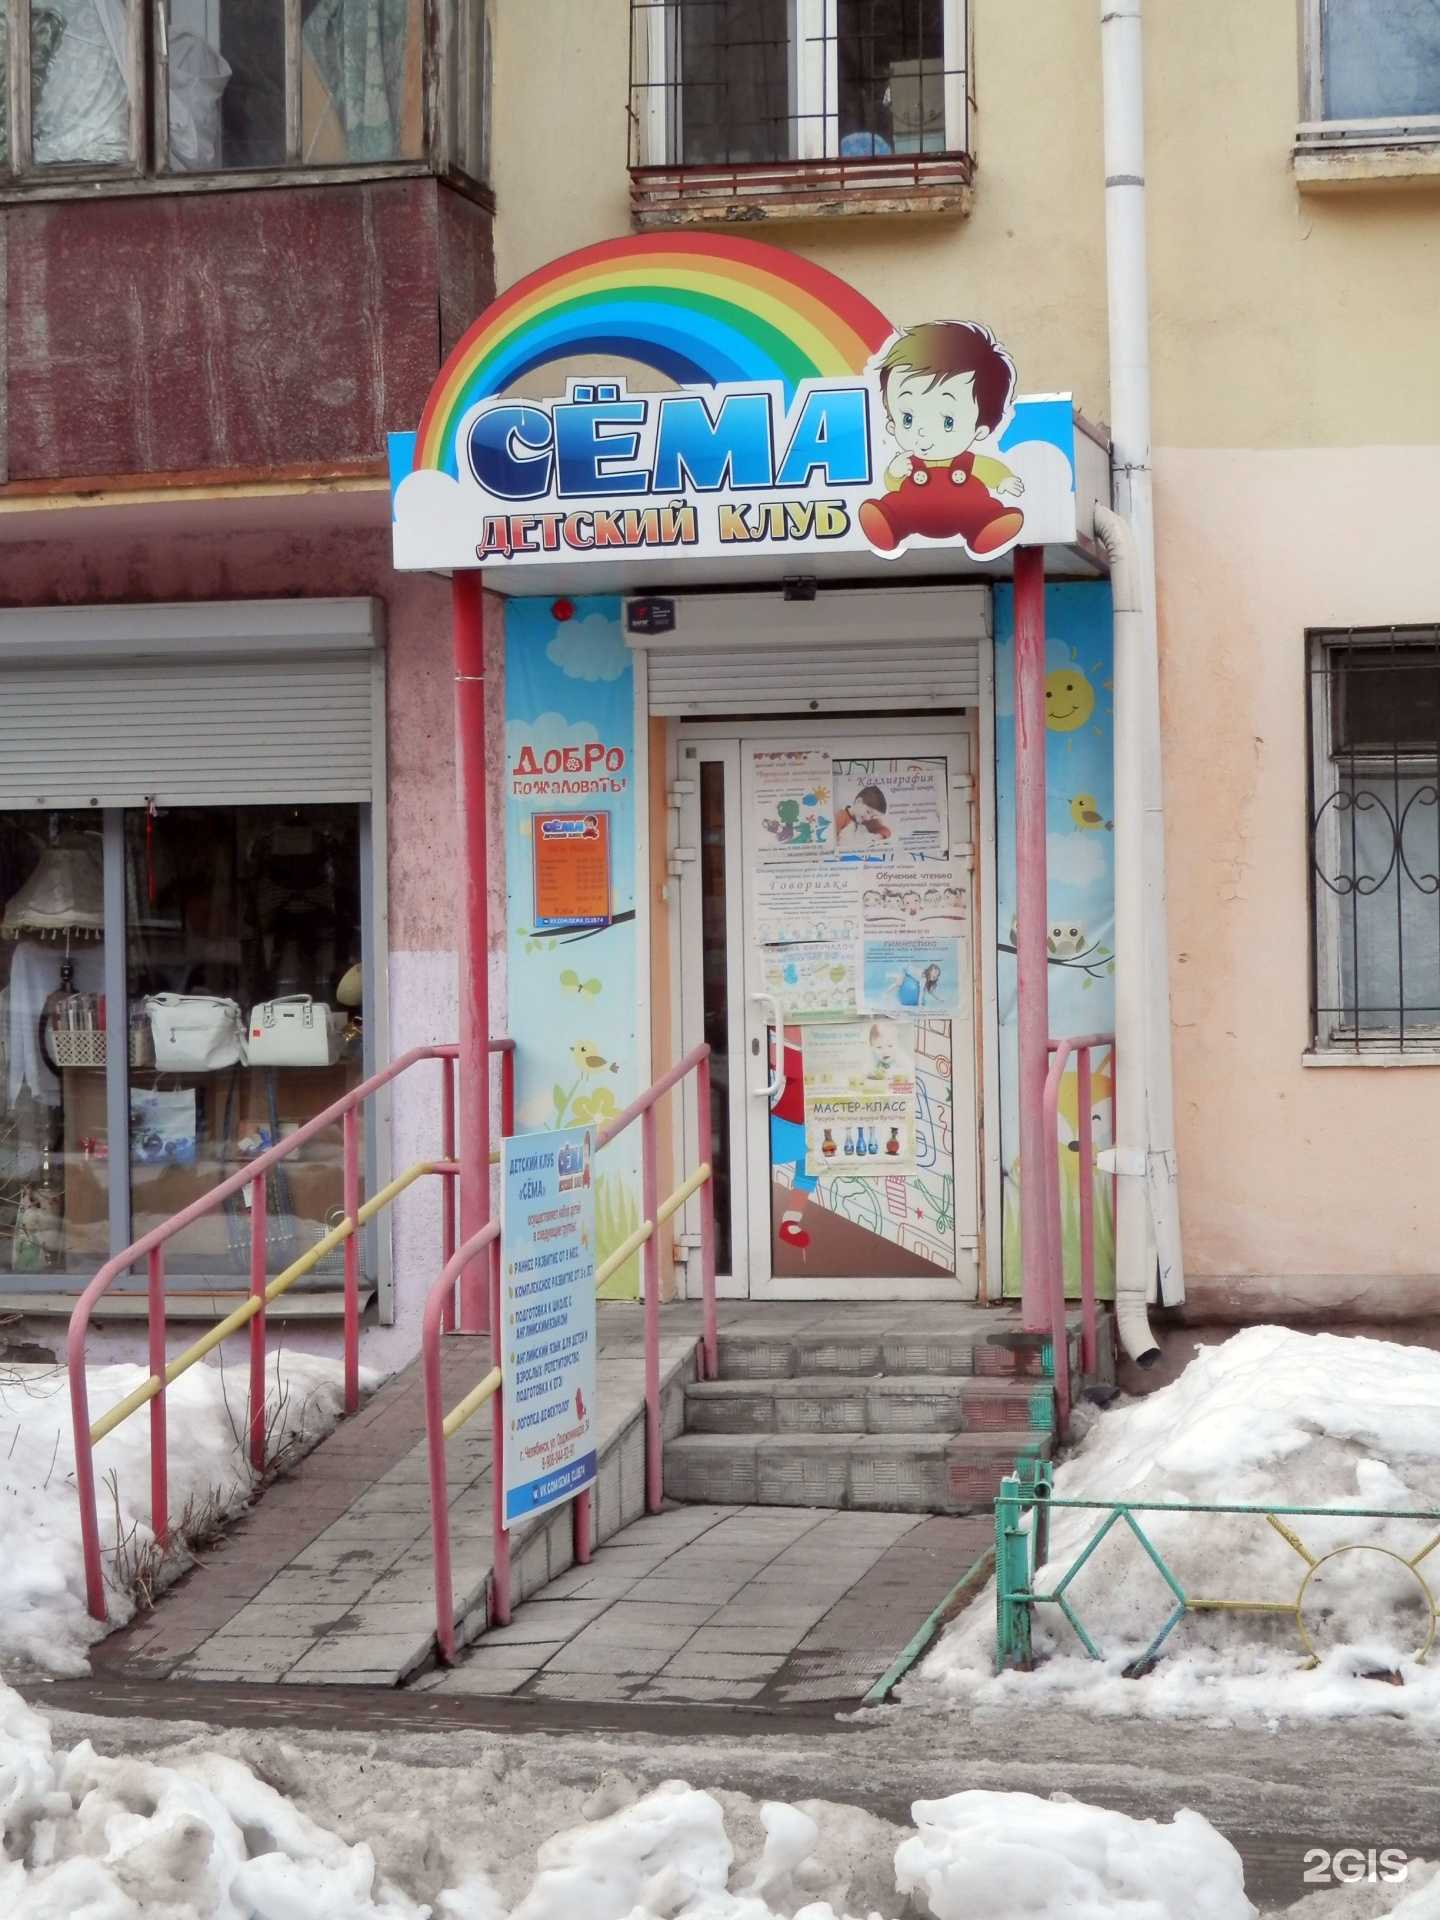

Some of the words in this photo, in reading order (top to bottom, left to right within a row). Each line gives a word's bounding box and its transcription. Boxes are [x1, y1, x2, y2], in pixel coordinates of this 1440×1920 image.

[468, 384, 873, 500] СЁМА
[476, 498, 700, 560] ДЕТСКИЙ
[718, 499, 851, 541] КЛУБ
[513, 743, 625, 776] ДОБРО
[857, 772, 934, 787] Каллиграфия
[876, 871, 918, 881] Обучение
[920, 872, 953, 880] чтению
[813, 1101, 907, 1113] МАСТЕР-КЛАСС
[509, 1152, 539, 1176] ДЕТСКИЙ
[539, 1152, 554, 1169] КЛУБ
[514, 1259, 534, 1275] РАННЕЕ
[535, 1251, 559, 1270] РАЗВИТИЕ
[514, 1279, 551, 1299] КОМПЛЕКСНОЕ
[515, 1303, 548, 1323] ПОДГОТОВКА
[516, 1365, 542, 1385] ВЗРОСЛЫХ
[516, 1383, 549, 1403] ПОДГОТОВКА
